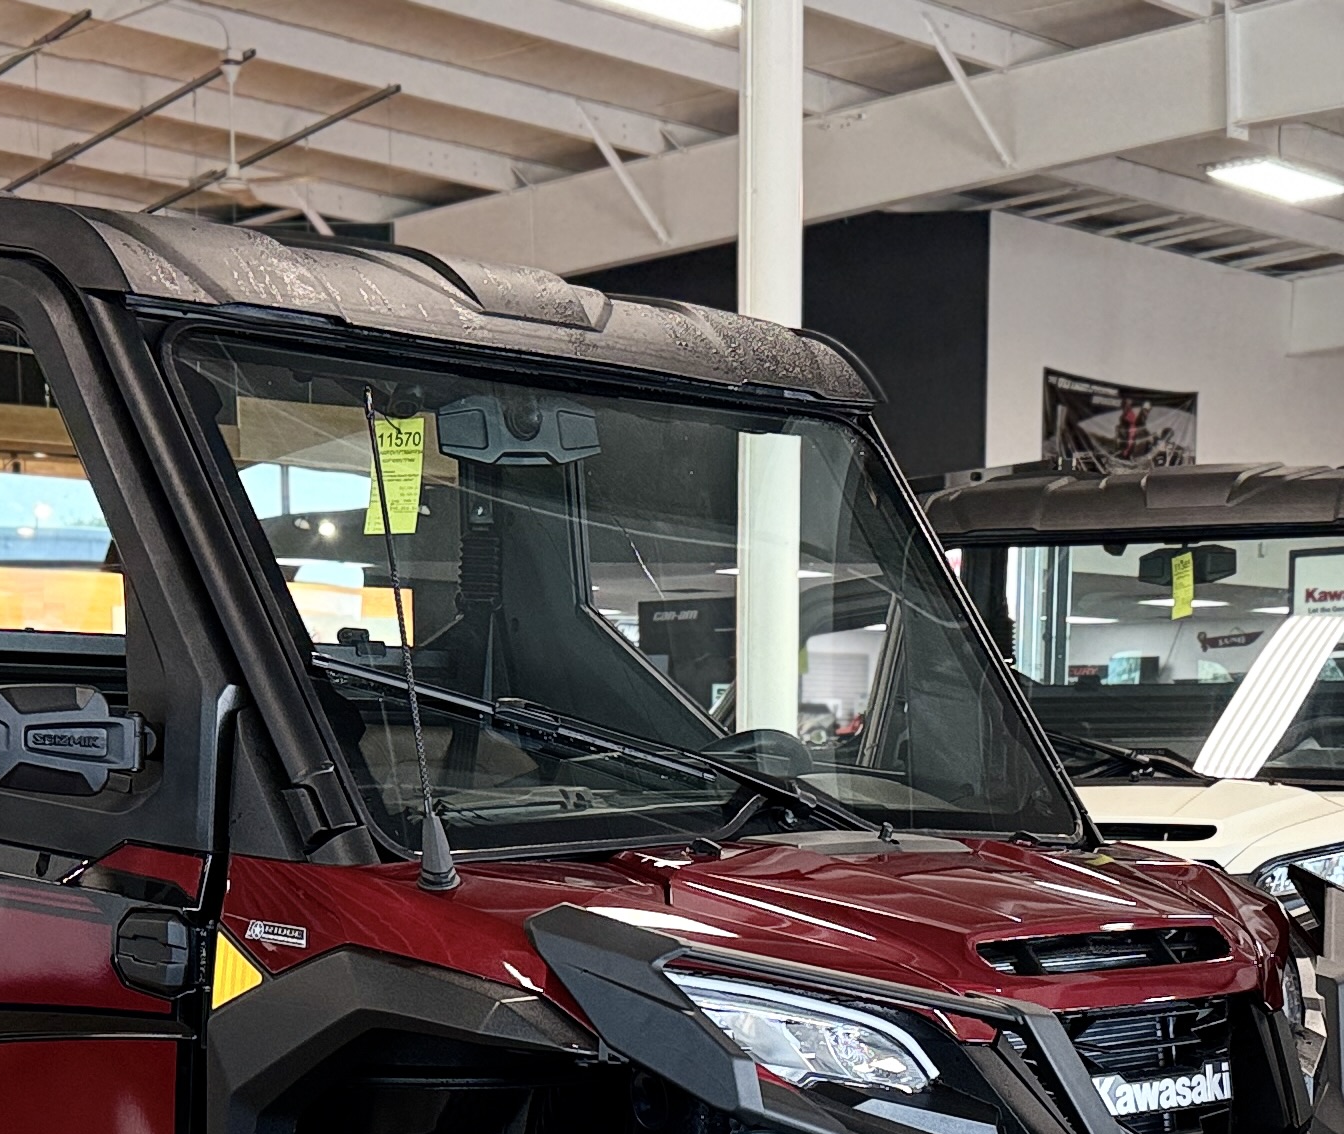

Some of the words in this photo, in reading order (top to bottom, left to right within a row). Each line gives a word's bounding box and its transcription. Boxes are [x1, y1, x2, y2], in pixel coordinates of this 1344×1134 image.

[377, 431, 422, 448] 11570
[32, 733, 101, 748] SEIZMIK
[1091, 1061, 1232, 1116] Kawasaki
